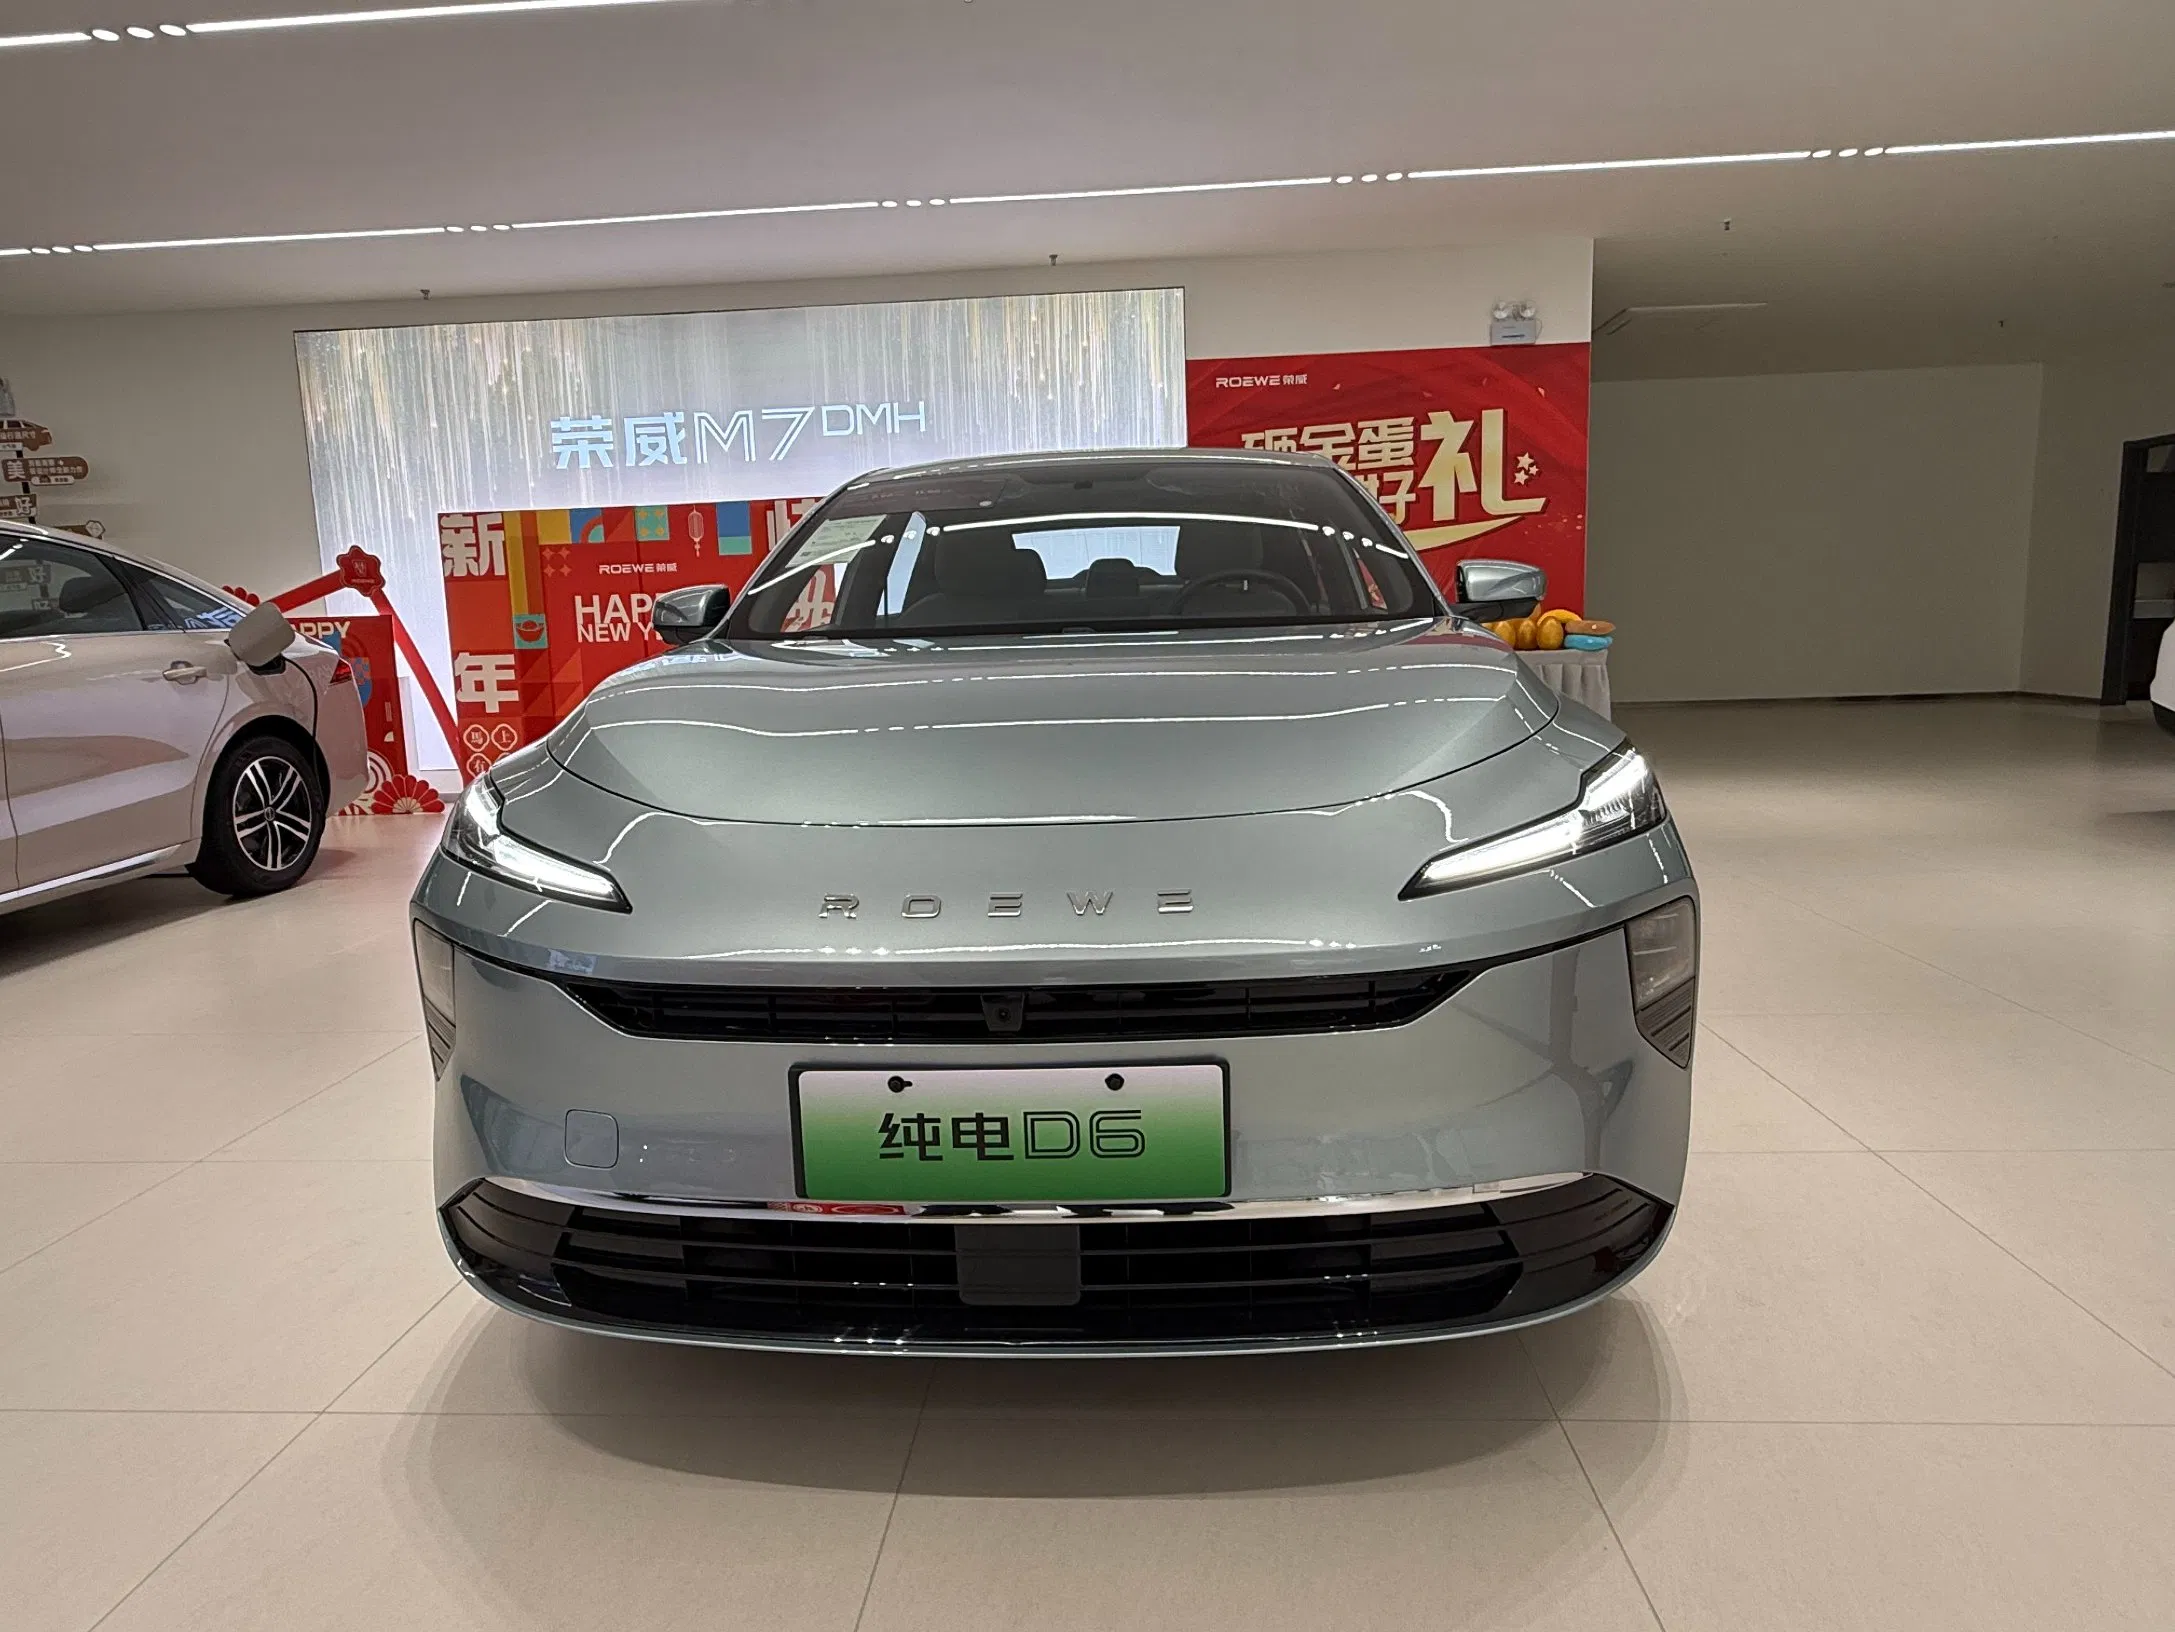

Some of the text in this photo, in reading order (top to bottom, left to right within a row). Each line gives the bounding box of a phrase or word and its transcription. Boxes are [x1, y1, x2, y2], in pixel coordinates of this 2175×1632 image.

[1215, 373, 1308, 388] ROEWE 荣威
[821, 401, 925, 436] DMH
[7, 460, 26, 480] 美
[1419, 408, 1547, 522] 礼
[440, 513, 506, 577] 新
[599, 562, 677, 575] ROEWE 荣威
[578, 622, 631, 643] NEW
[454, 652, 519, 713] 年
[818, 888, 1195, 919] ROEWE
